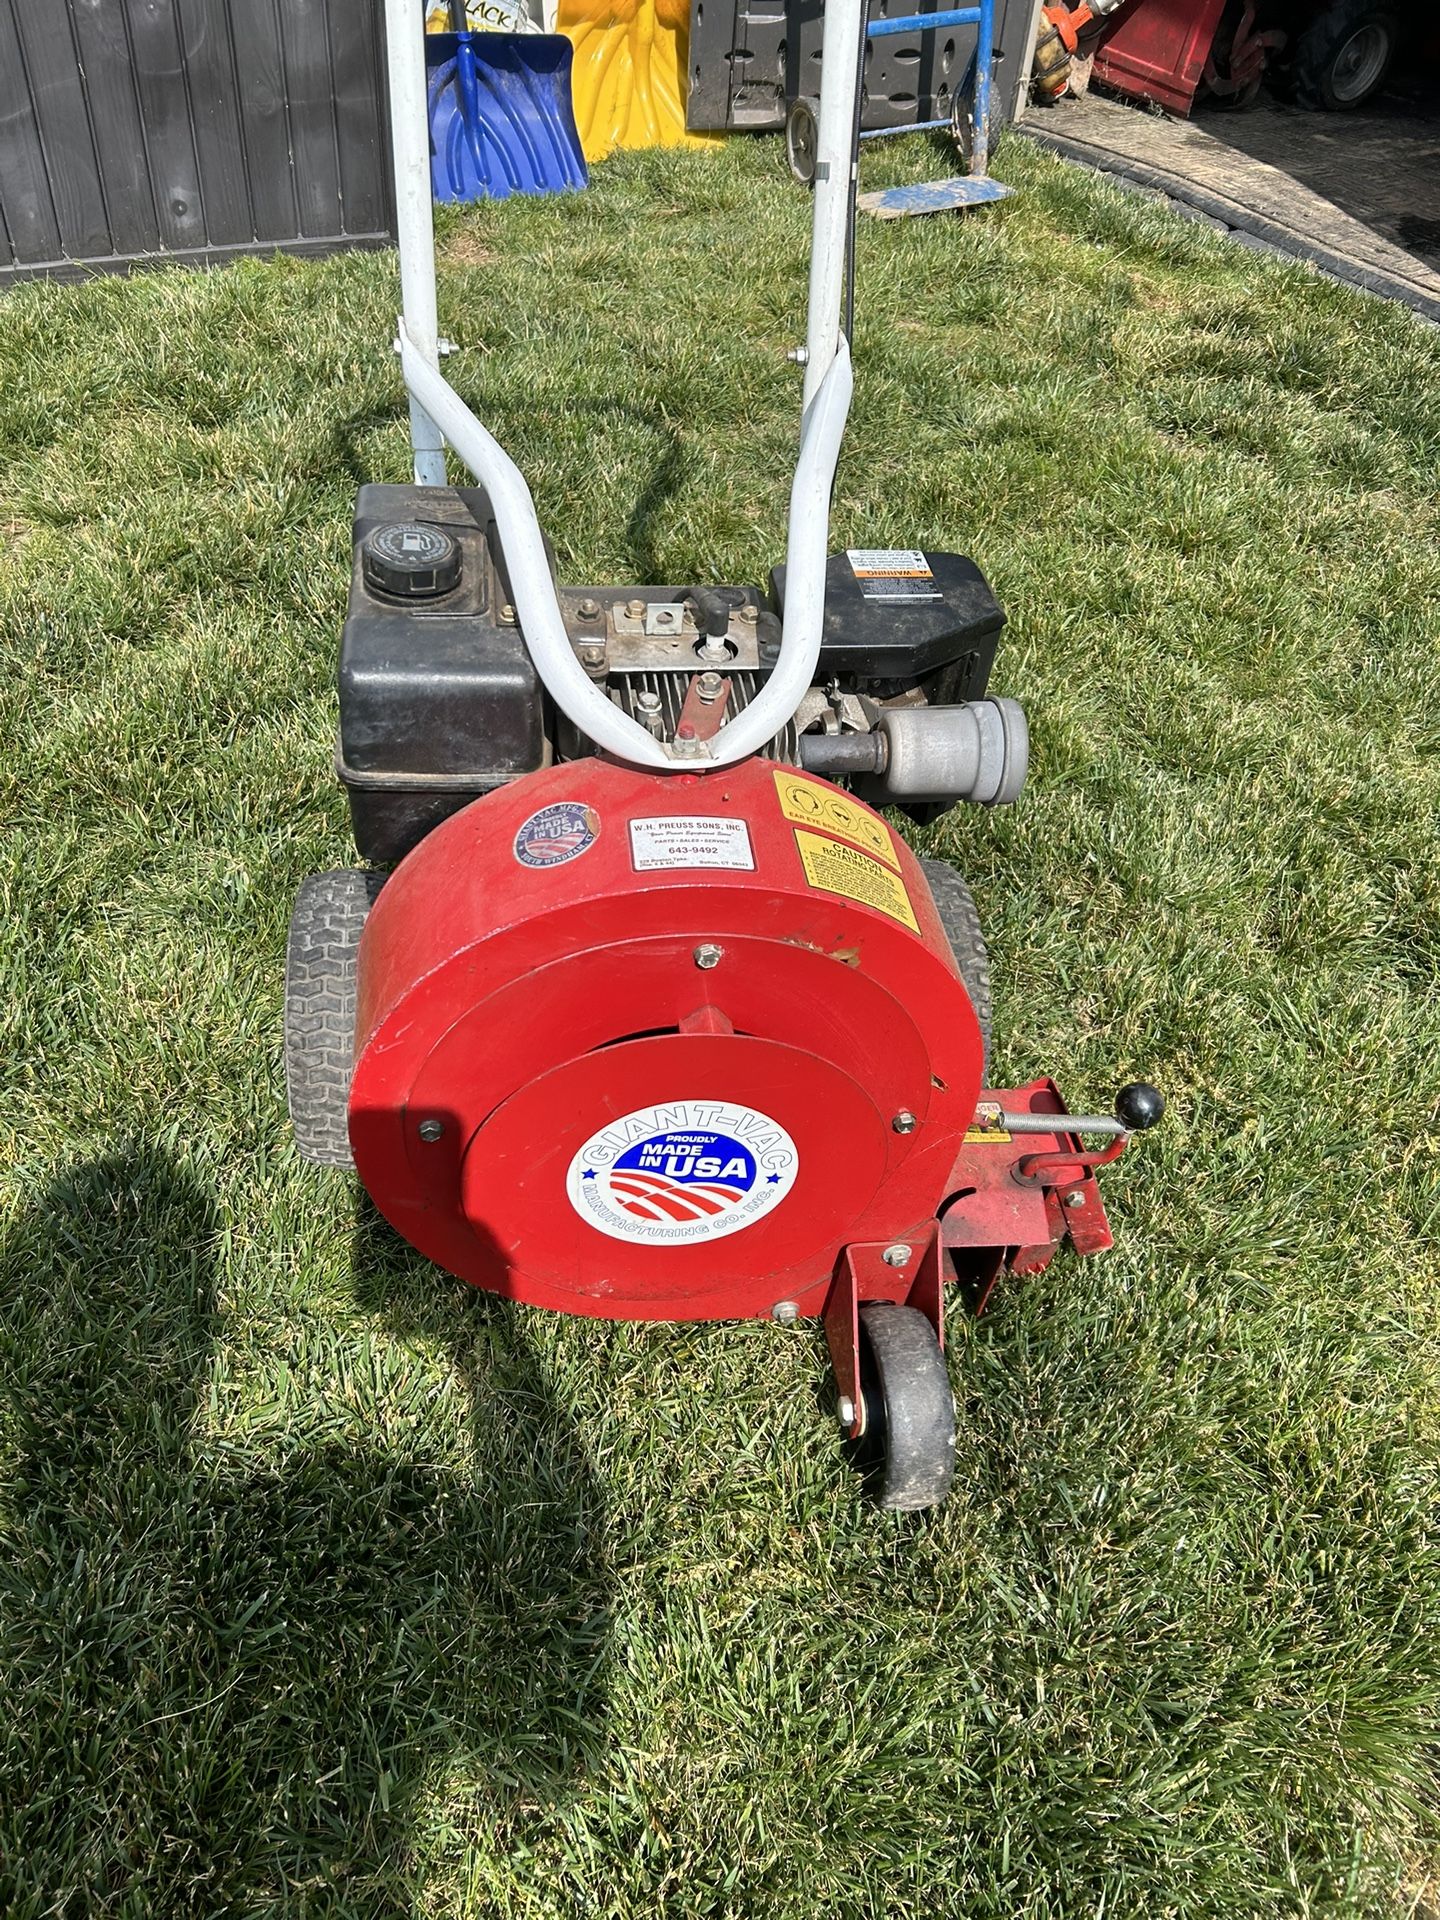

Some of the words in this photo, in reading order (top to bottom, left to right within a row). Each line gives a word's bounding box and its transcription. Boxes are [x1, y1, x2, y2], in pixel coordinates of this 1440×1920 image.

[465, 0, 512, 28] LACK
[534, 816, 569, 833] MADE
[534, 831, 546, 839] IN
[550, 820, 585, 838] USA
[634, 822, 655, 832] W.H.
[658, 821, 695, 830] PREUSS
[696, 822, 725, 830] SONS,
[726, 823, 745, 832] INC.
[789, 811, 806, 820] EAR
[806, 816, 822, 826] EYE
[822, 820, 862, 843] BREATHING
[668, 846, 719, 855] 643-9492
[832, 843, 883, 874] CAUTION
[822, 846, 868, 871] ROTATING
[868, 866, 895, 888] PARTS
[582, 1104, 793, 1171] GIANT-VAC
[665, 1134, 718, 1144] PROUDLY
[642, 1144, 704, 1157] MADE
[638, 1155, 661, 1168] IN
[664, 1156, 748, 1179] USA
[582, 1183, 710, 1238] MANUFACTURING
[712, 1208, 746, 1229] CO.
[748, 1188, 775, 1217] INC.
